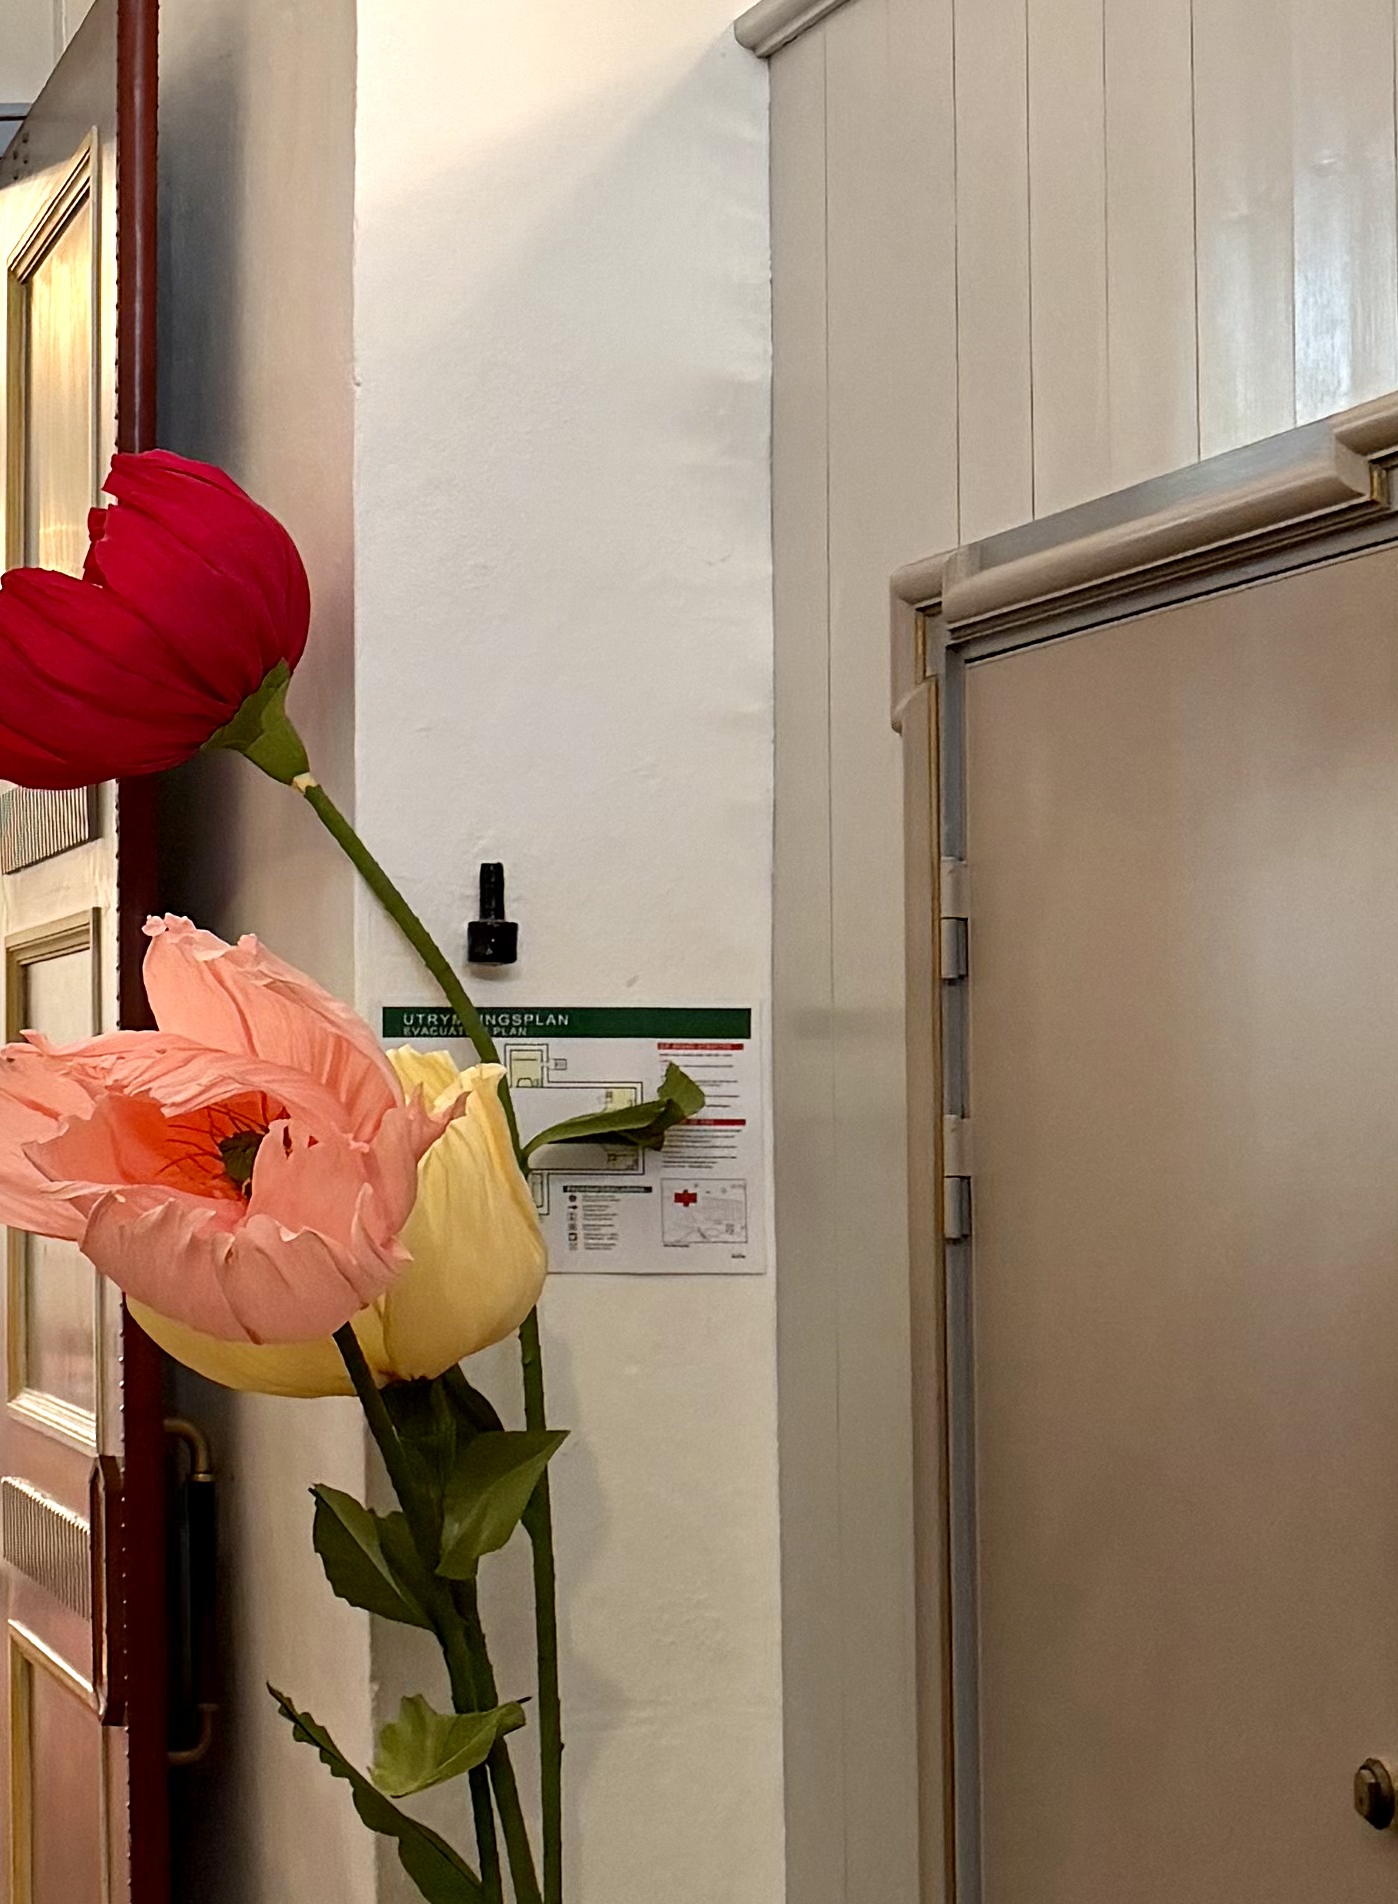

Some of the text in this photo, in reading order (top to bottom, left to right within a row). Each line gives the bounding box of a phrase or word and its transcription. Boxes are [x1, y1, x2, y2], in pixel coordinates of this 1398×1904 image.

[403, 1013, 570, 1027] UTRYINGSPLAN
[403, 1026, 527, 1037] EVACUAT PLAN
